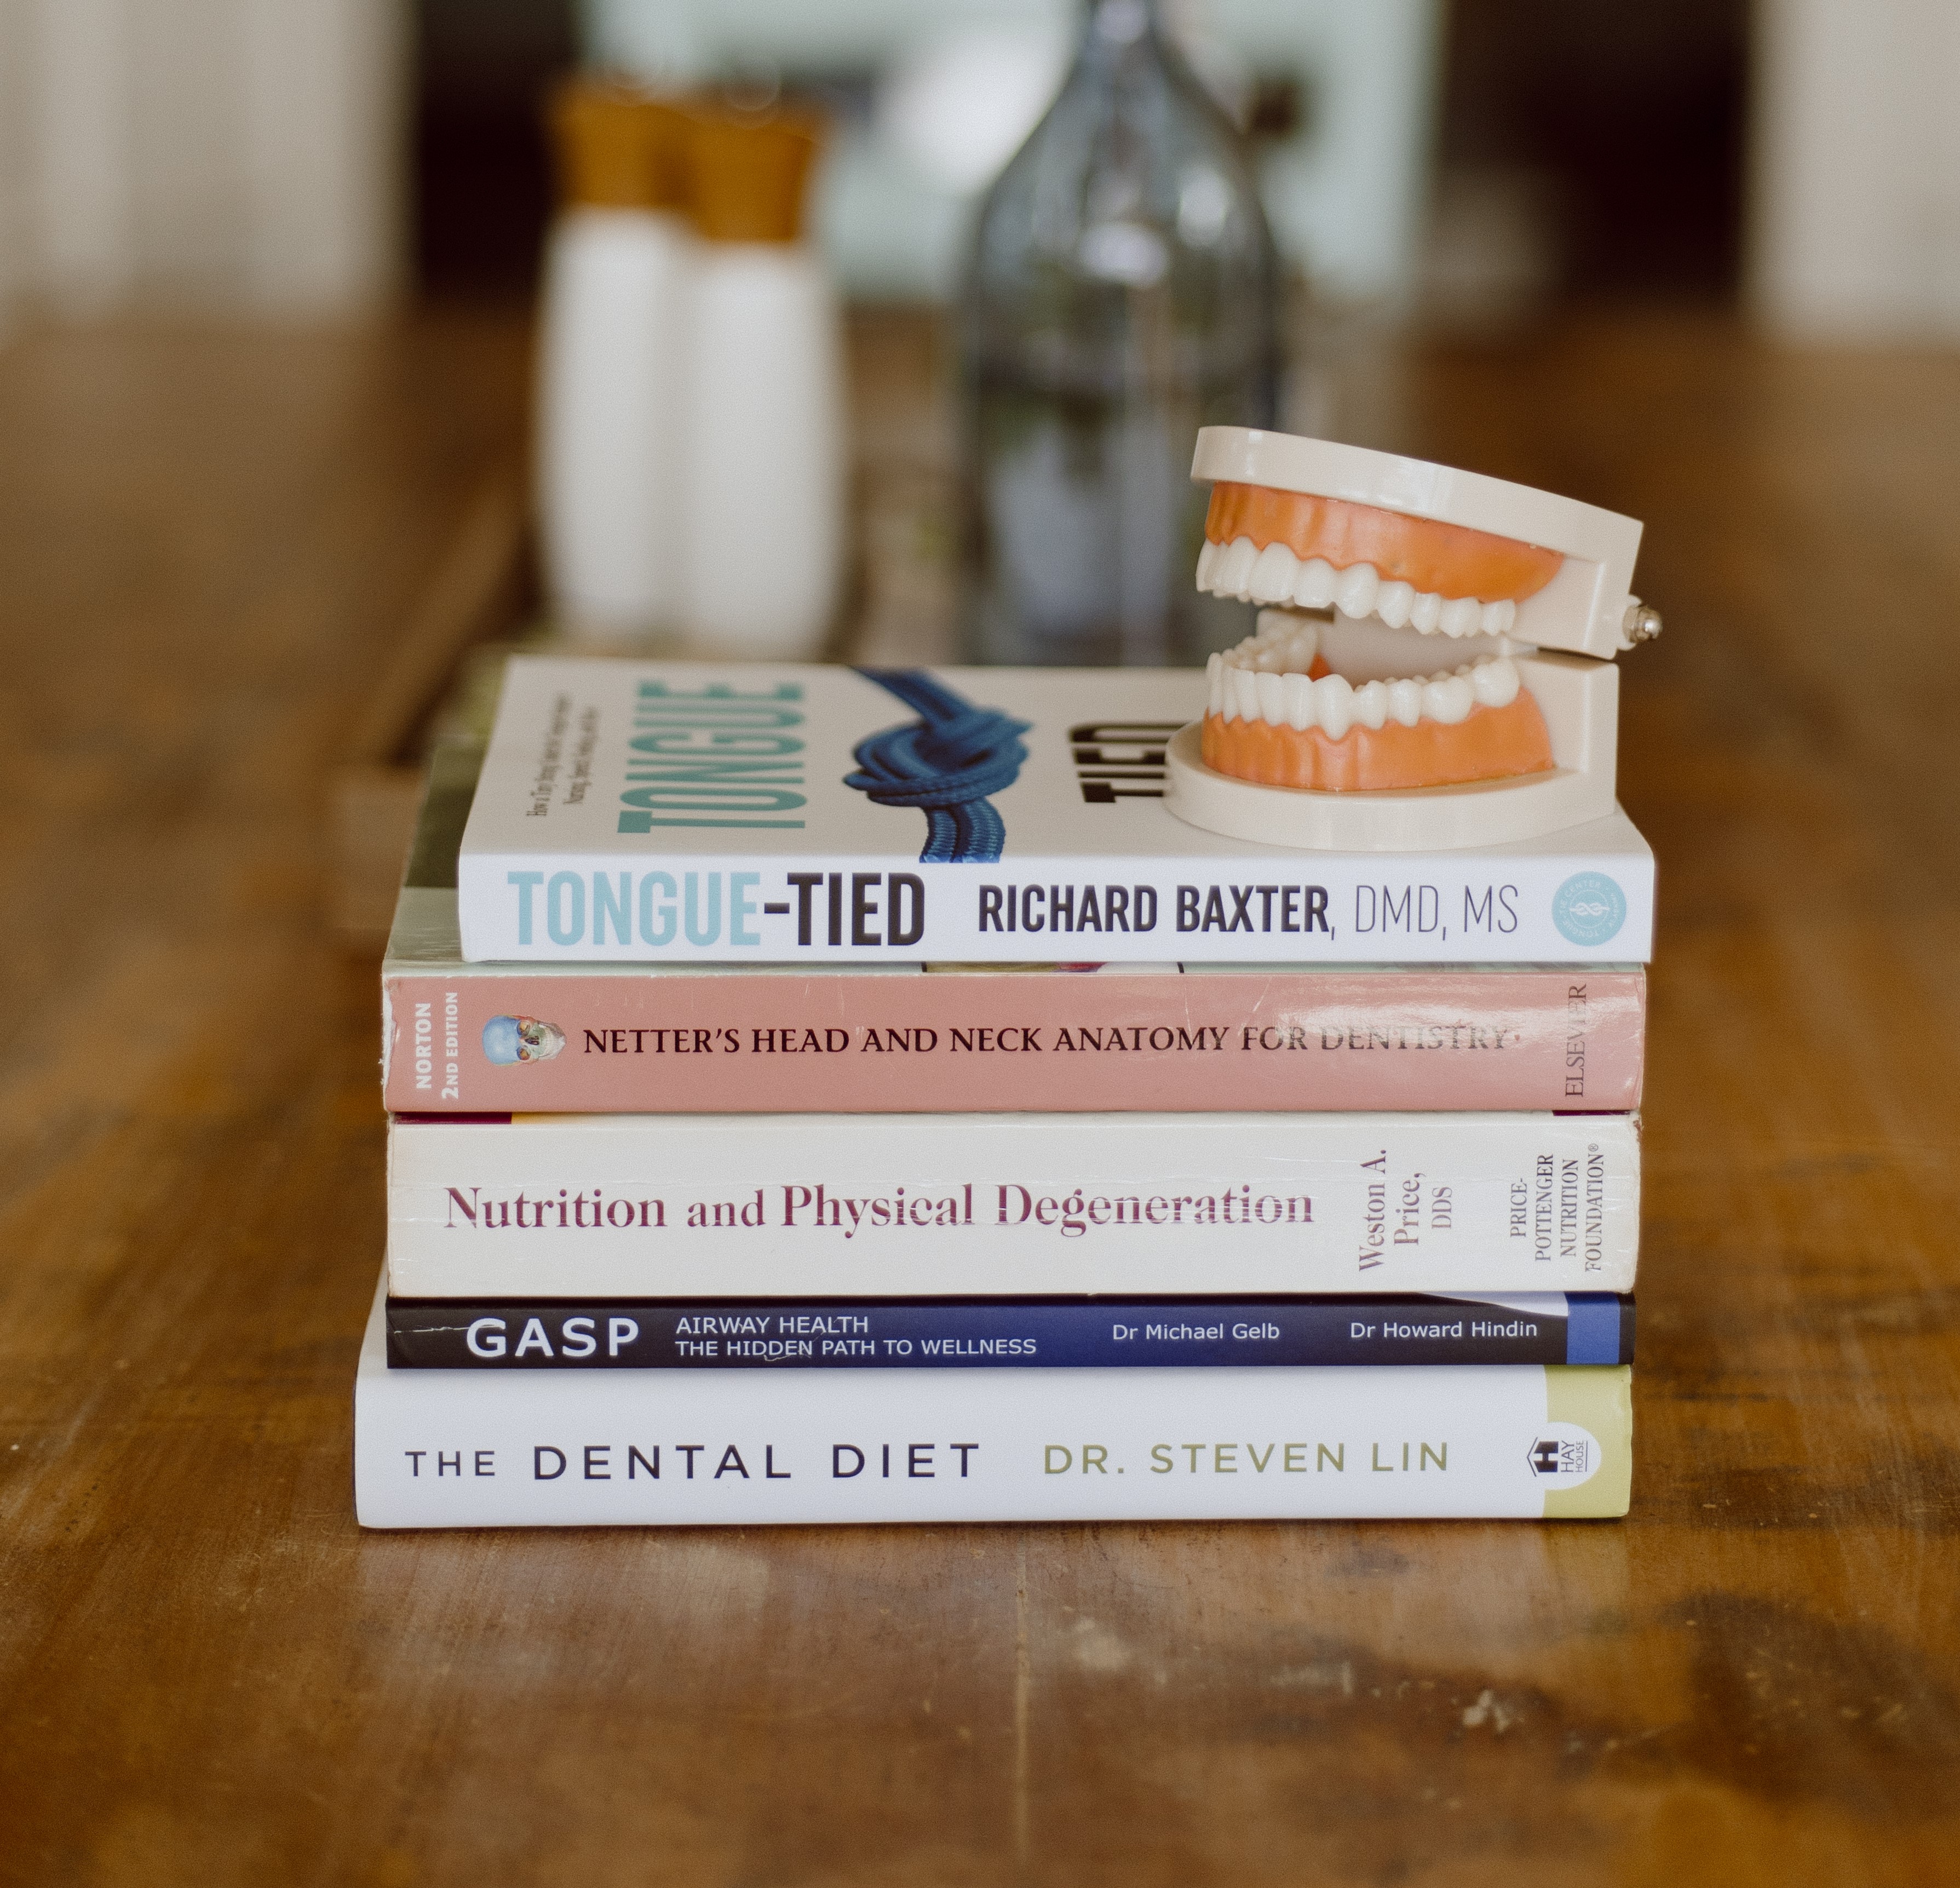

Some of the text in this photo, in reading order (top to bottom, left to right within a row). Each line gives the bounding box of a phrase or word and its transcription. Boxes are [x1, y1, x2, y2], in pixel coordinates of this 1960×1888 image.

[617, 680, 808, 834] TONGUE
[507, 870, 926, 946] TONGUE-TIED
[979, 883, 1518, 940] RICHARD BAXTER, DMD, MS
[415, 1002, 432, 1089] NORTON
[441, 991, 459, 1099] 2ND EDITION
[583, 1024, 1509, 1053] NETTER'S HEAD AND NECK ANATOMY FOR DENTISTRY
[1565, 983, 1588, 1098] ELSEVIER
[443, 1183, 1315, 1239] Nutrition and Physical Degeneration
[1358, 1149, 1387, 1272] Weston A.
[1393, 1172, 1427, 1246] Price,
[1431, 1186, 1453, 1230] DDS
[1509, 1178, 1528, 1238] PRICE-
[1534, 1153, 1554, 1262] POTTENGER
[1560, 1158, 1579, 1258] NUTRITION
[466, 1317, 640, 1357] GASP
[675, 1316, 869, 1334] AIRWAY HEALTH
[675, 1338, 1037, 1356] THE HIDDEN PATH TO WELLNESS
[1113, 1323, 1281, 1341] Dr Michael Gelb
[1350, 1321, 1538, 1339] Dr Howard Hindin
[405, 1443, 979, 1480] THE DENTAL DIET
[1044, 1441, 1448, 1475] DR. STEVEN LIN
[1561, 1440, 1574, 1473] HAY
[1575, 1440, 1584, 1473] HOUSE
